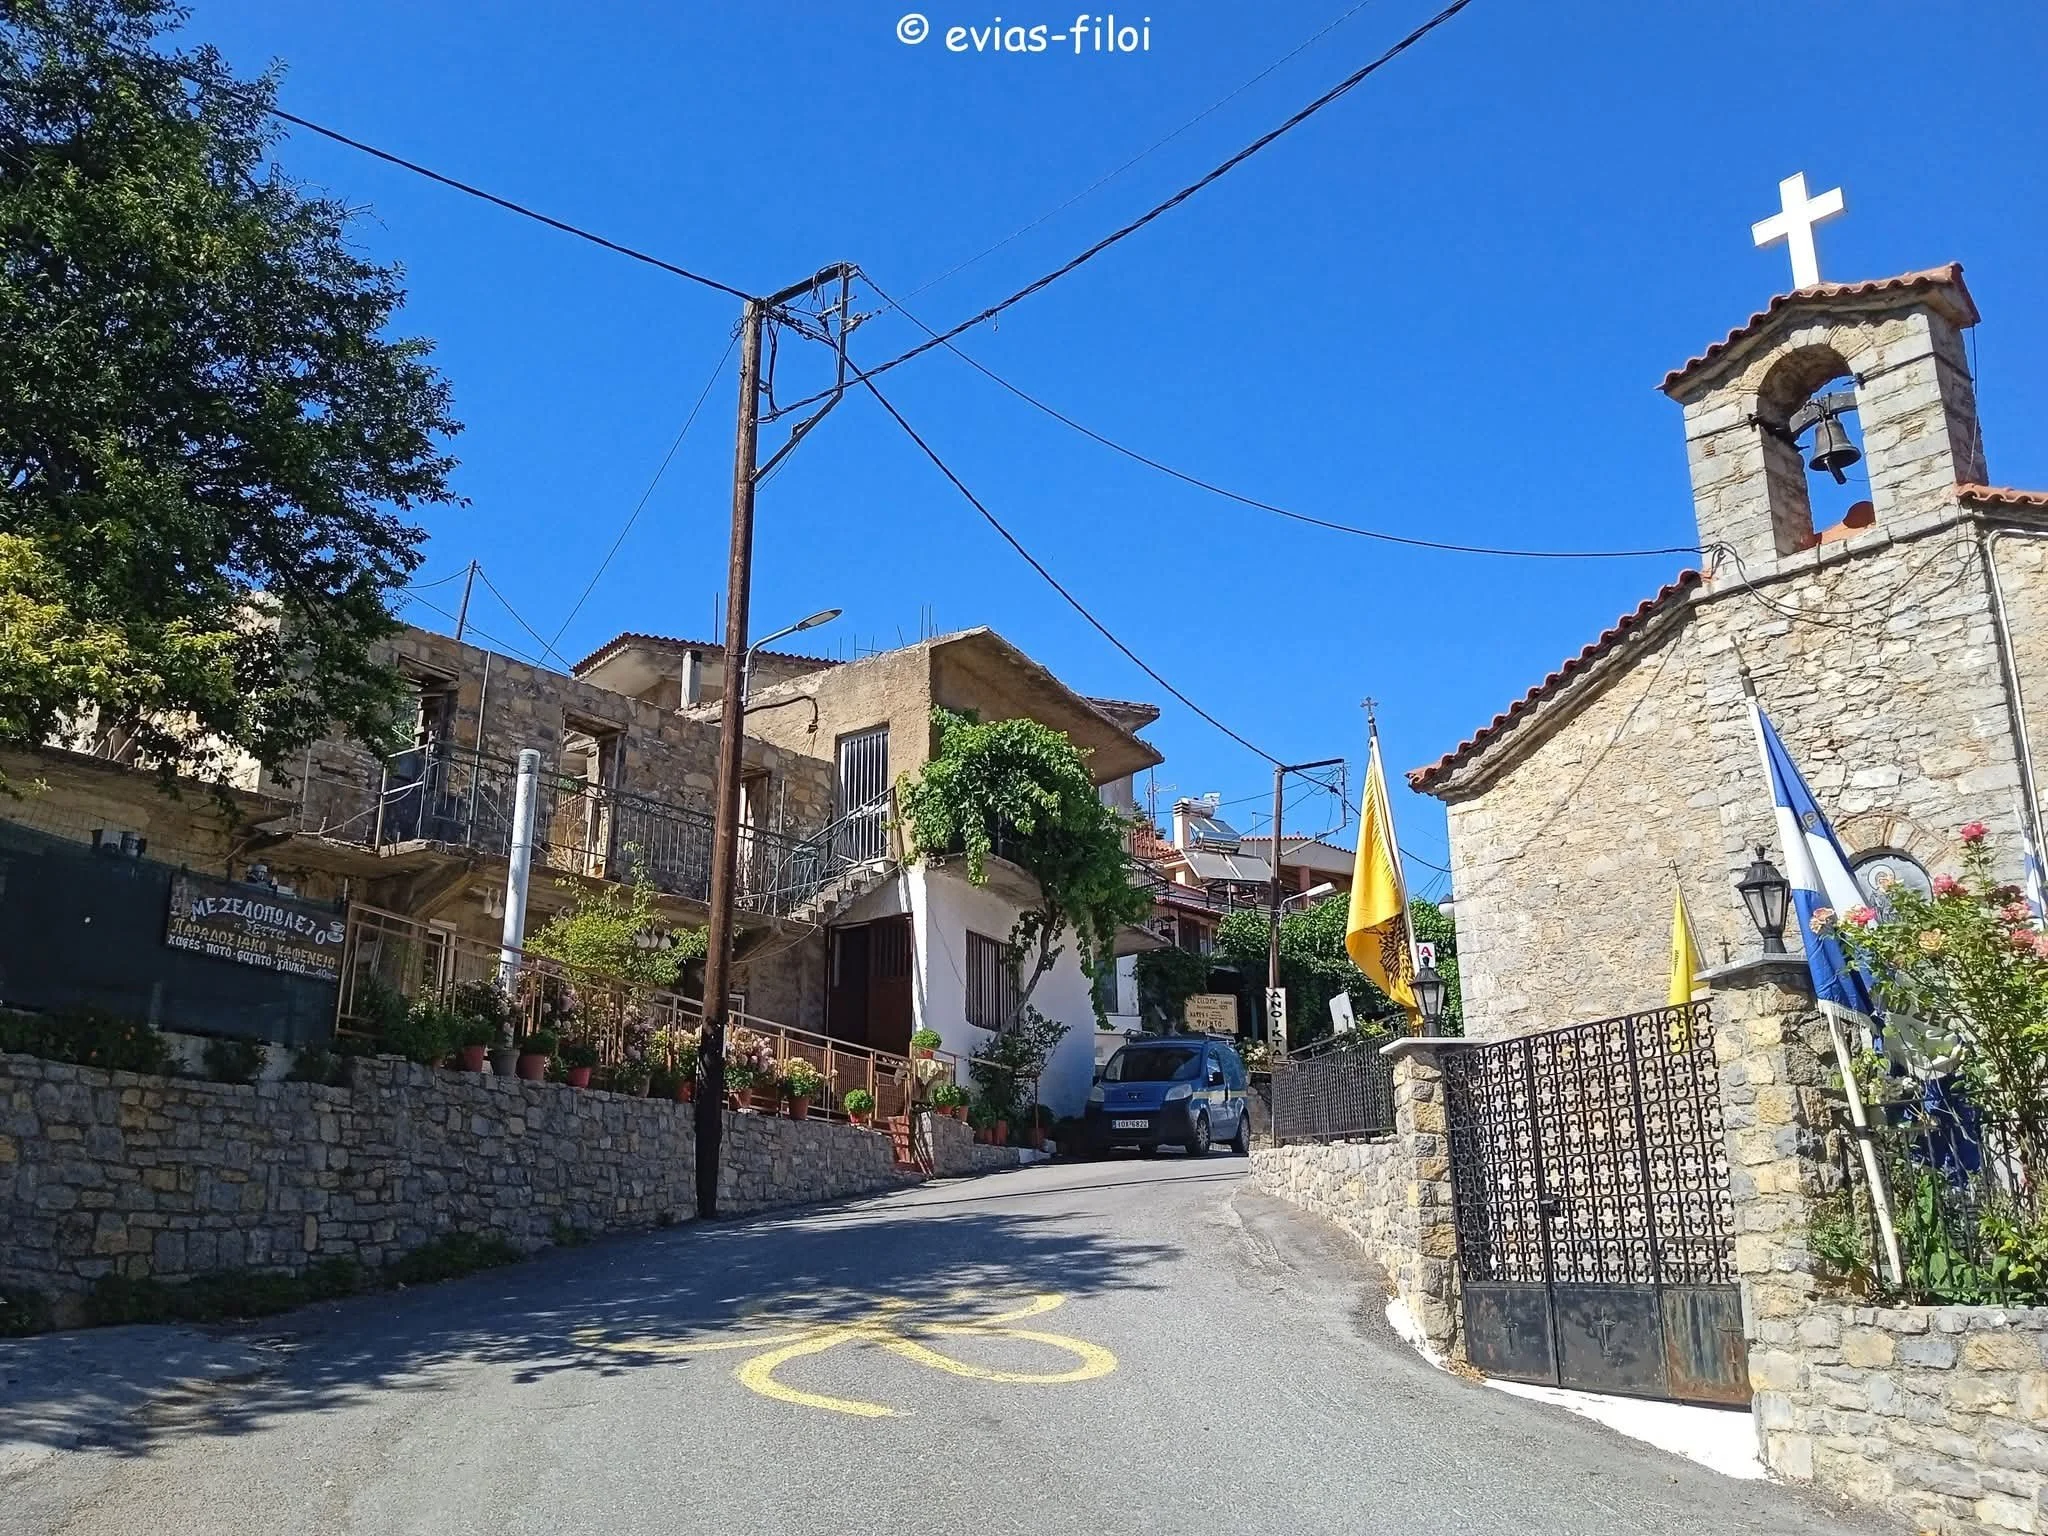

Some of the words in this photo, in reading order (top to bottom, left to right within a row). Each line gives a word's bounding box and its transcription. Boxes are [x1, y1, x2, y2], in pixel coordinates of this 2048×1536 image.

[171, 918, 267, 953] ΠΑΡΑΔΟΣΙΑΚΟ
[275, 944, 335, 970] ΚΑΦΕΝΕΙΟ
[191, 897, 326, 945] ΜΕΖΕΔΟΠΩΛΕΙΟ
[1270, 991, 1283, 1056] ΑΝΟΙΚΤΑ
